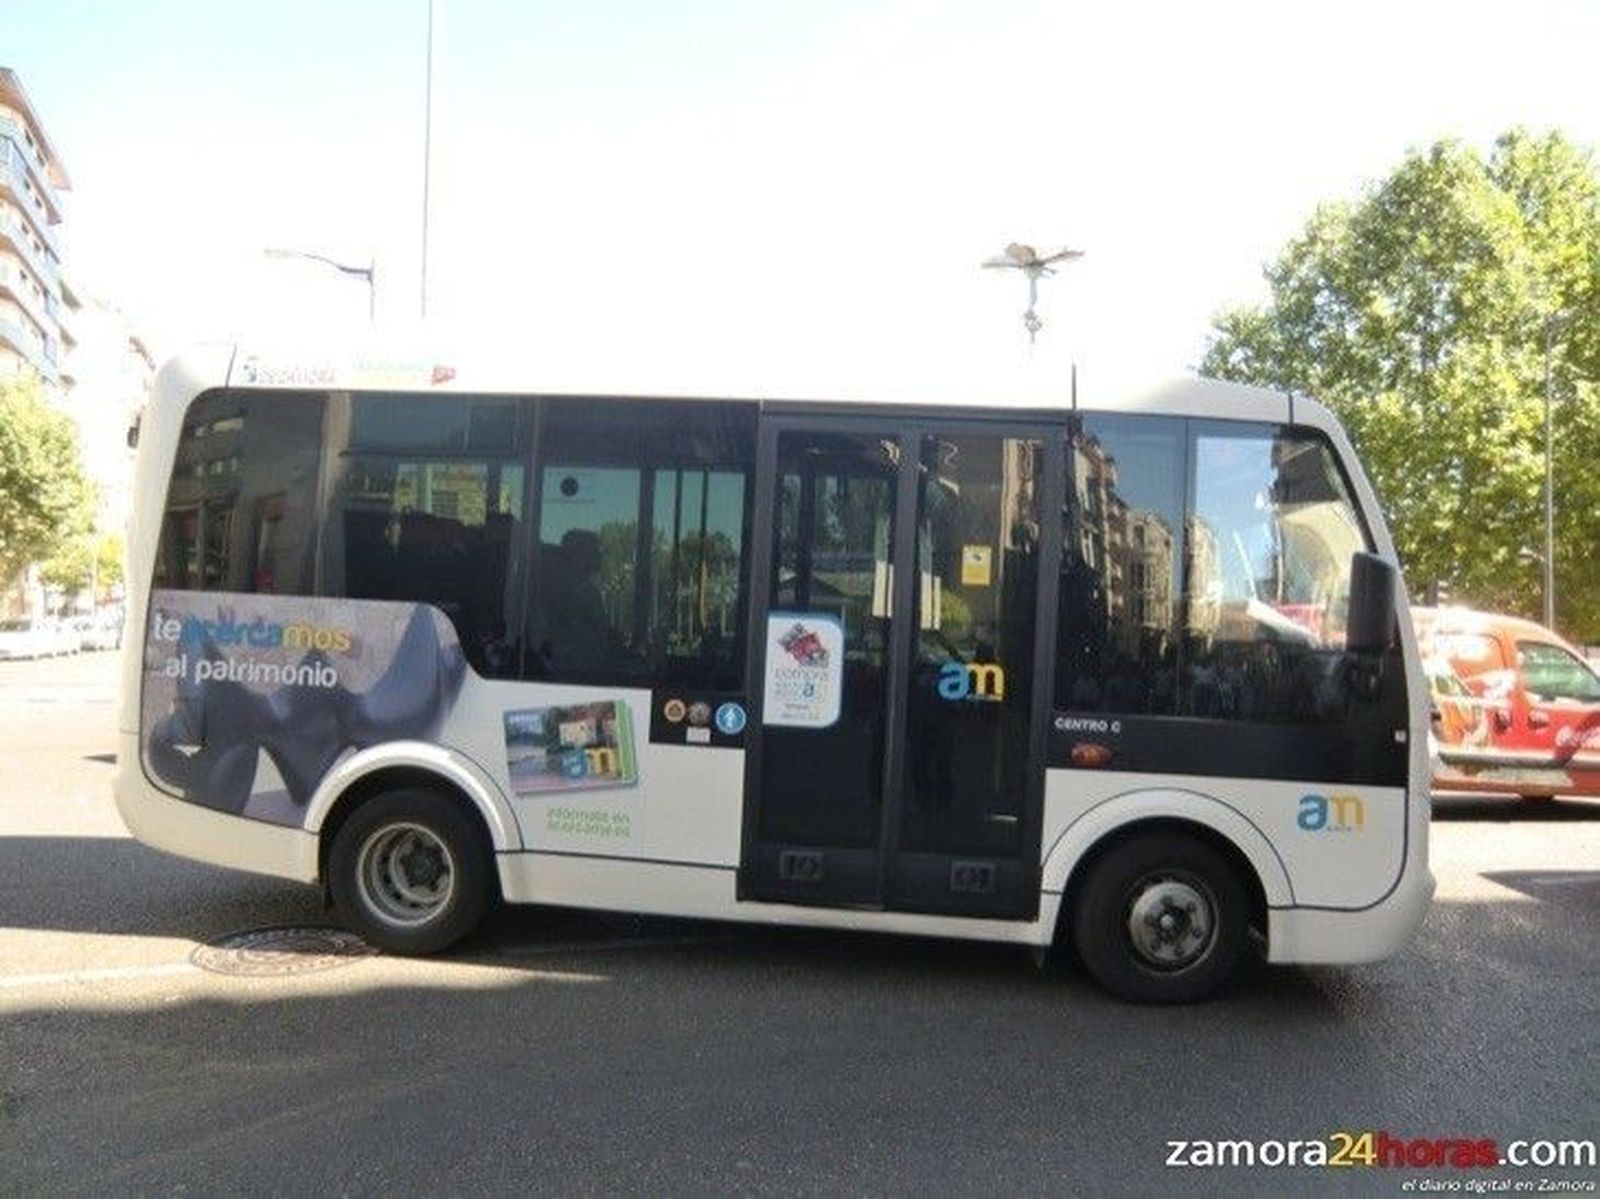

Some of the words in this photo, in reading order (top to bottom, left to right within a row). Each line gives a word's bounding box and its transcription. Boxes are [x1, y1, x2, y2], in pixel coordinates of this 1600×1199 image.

[194, 657, 338, 689] patrimonio
[937, 660, 1005, 701] am
[1054, 716, 1109, 733] CENTRO
[1297, 793, 1364, 831] am
